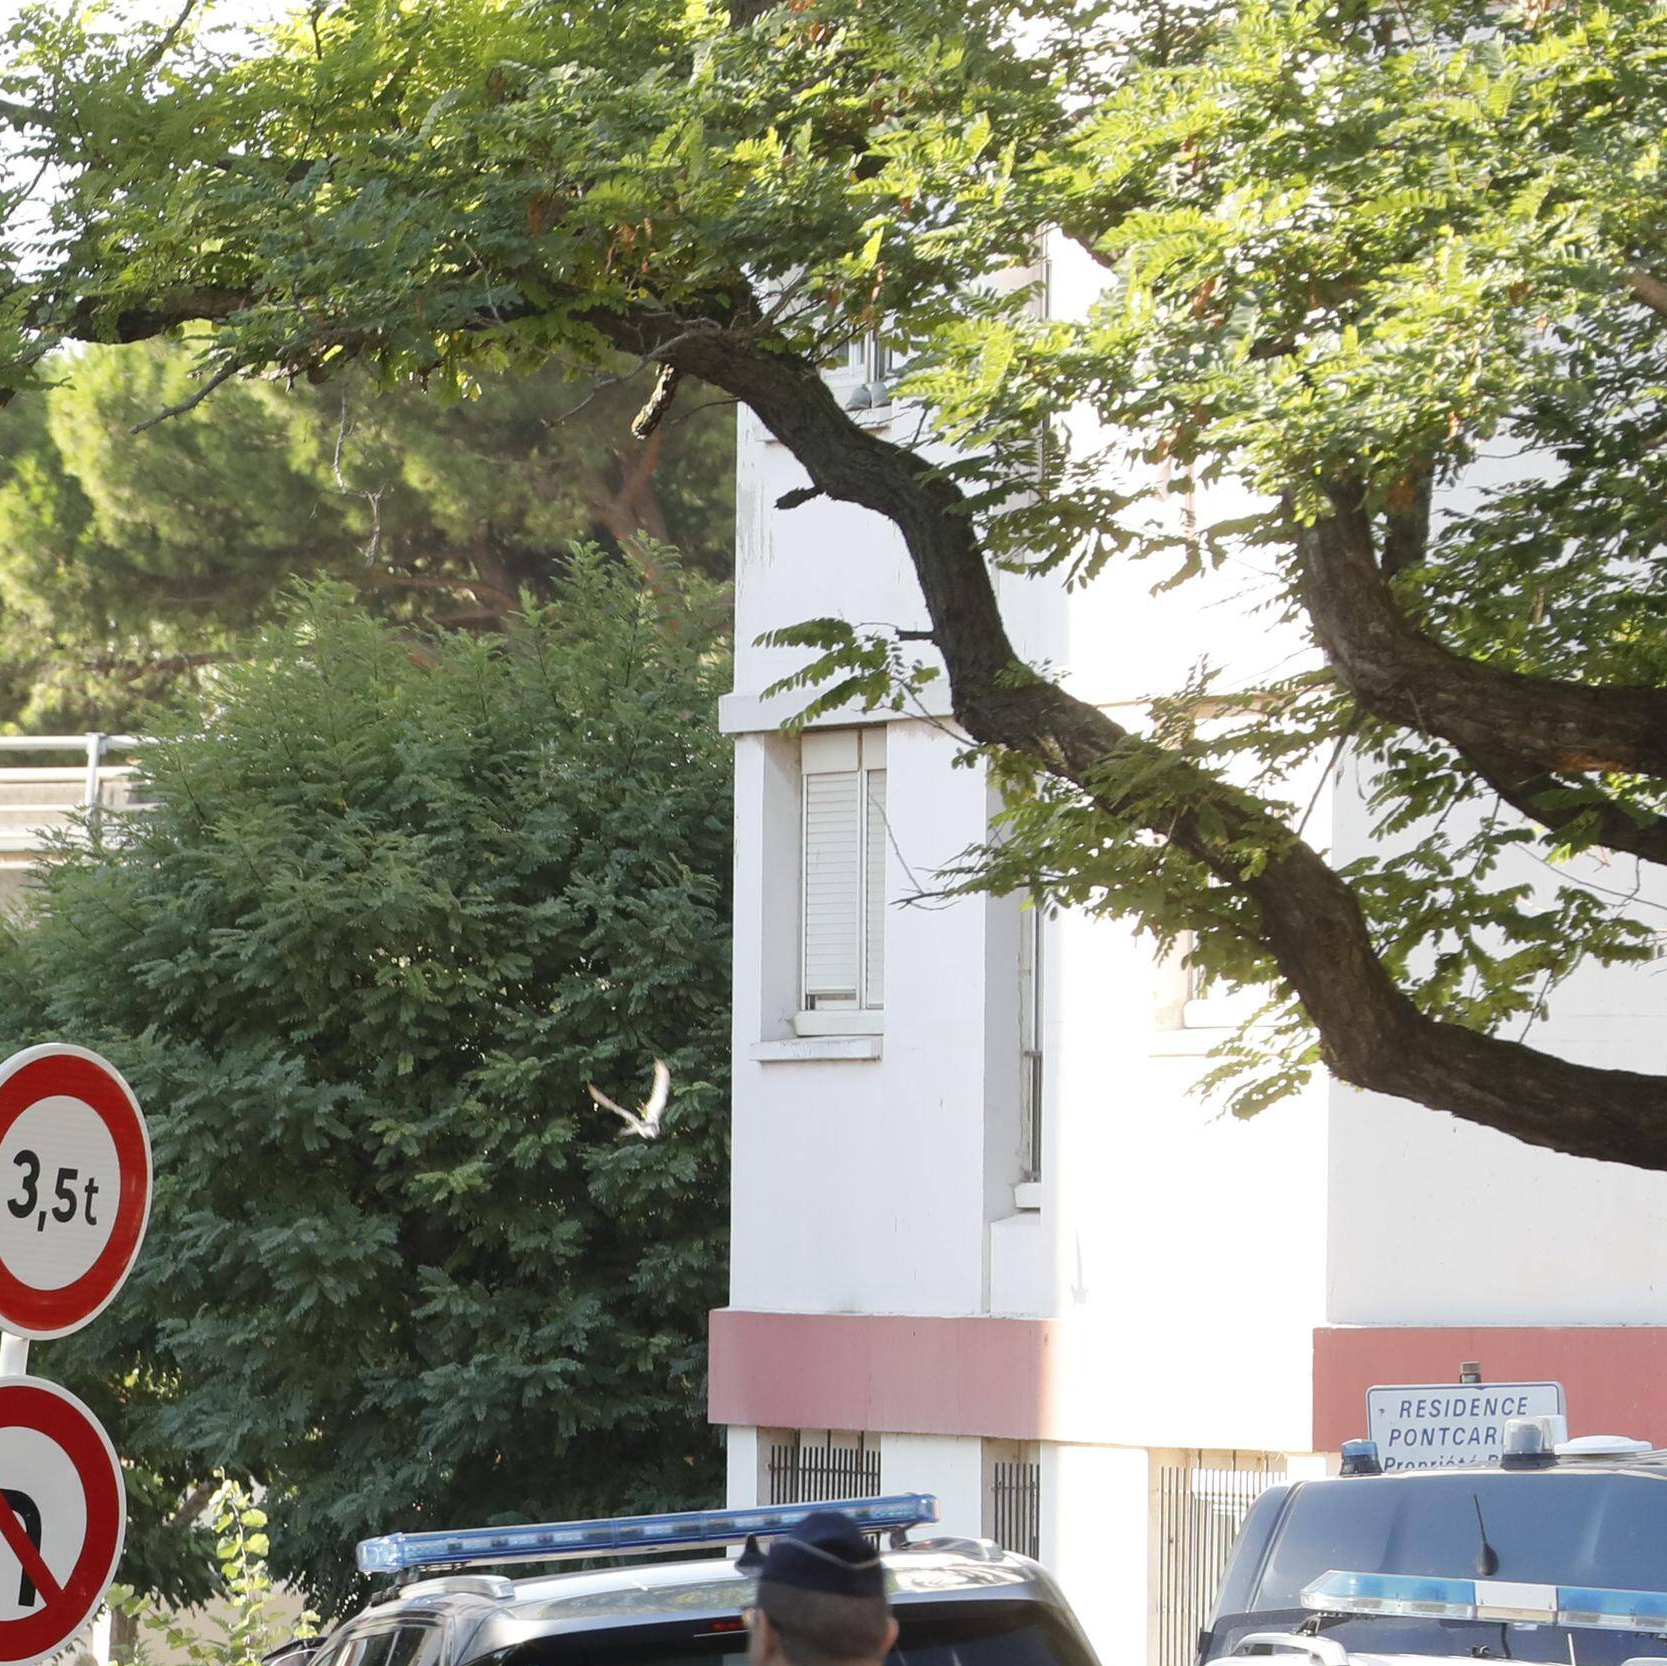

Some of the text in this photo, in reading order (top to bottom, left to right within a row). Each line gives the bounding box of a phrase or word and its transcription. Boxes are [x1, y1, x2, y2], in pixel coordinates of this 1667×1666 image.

[7, 1149, 99, 1232] 3,5t
[1399, 1397, 1528, 1418] RESIDENCE
[1389, 1427, 1504, 1447] PONTCAR
